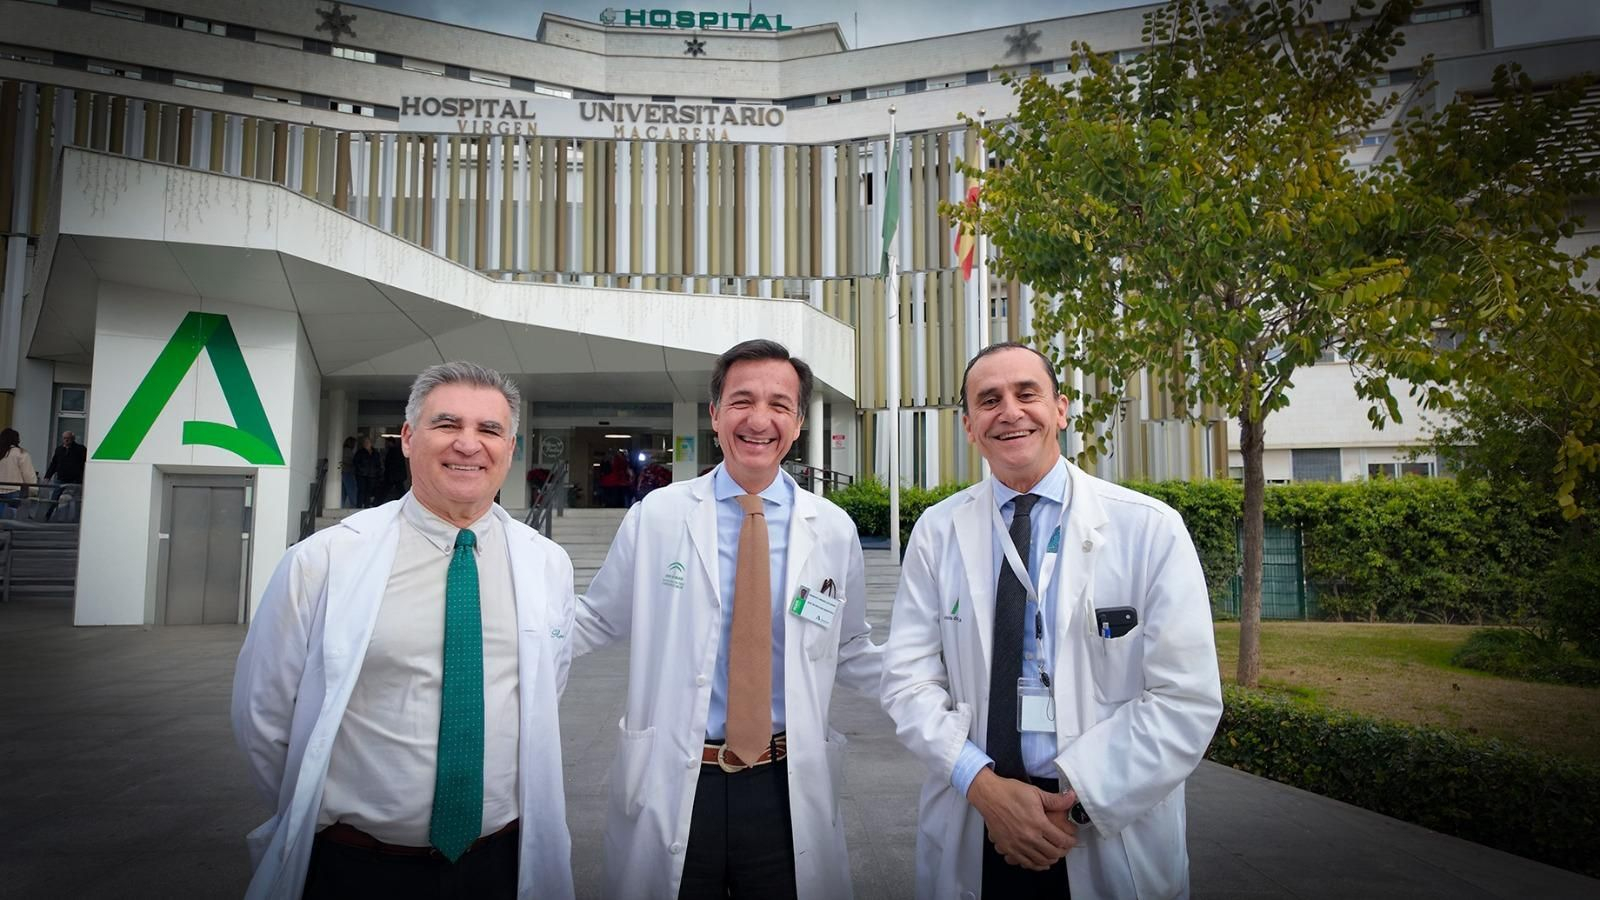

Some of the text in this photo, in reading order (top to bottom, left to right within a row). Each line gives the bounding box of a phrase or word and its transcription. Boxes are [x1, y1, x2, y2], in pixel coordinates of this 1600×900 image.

[625, 9, 792, 32] HOSPITAL
[401, 96, 784, 127] HOSPITAL UNIVERSITARIO
[457, 119, 730, 141] VIRGEN MACARENA
